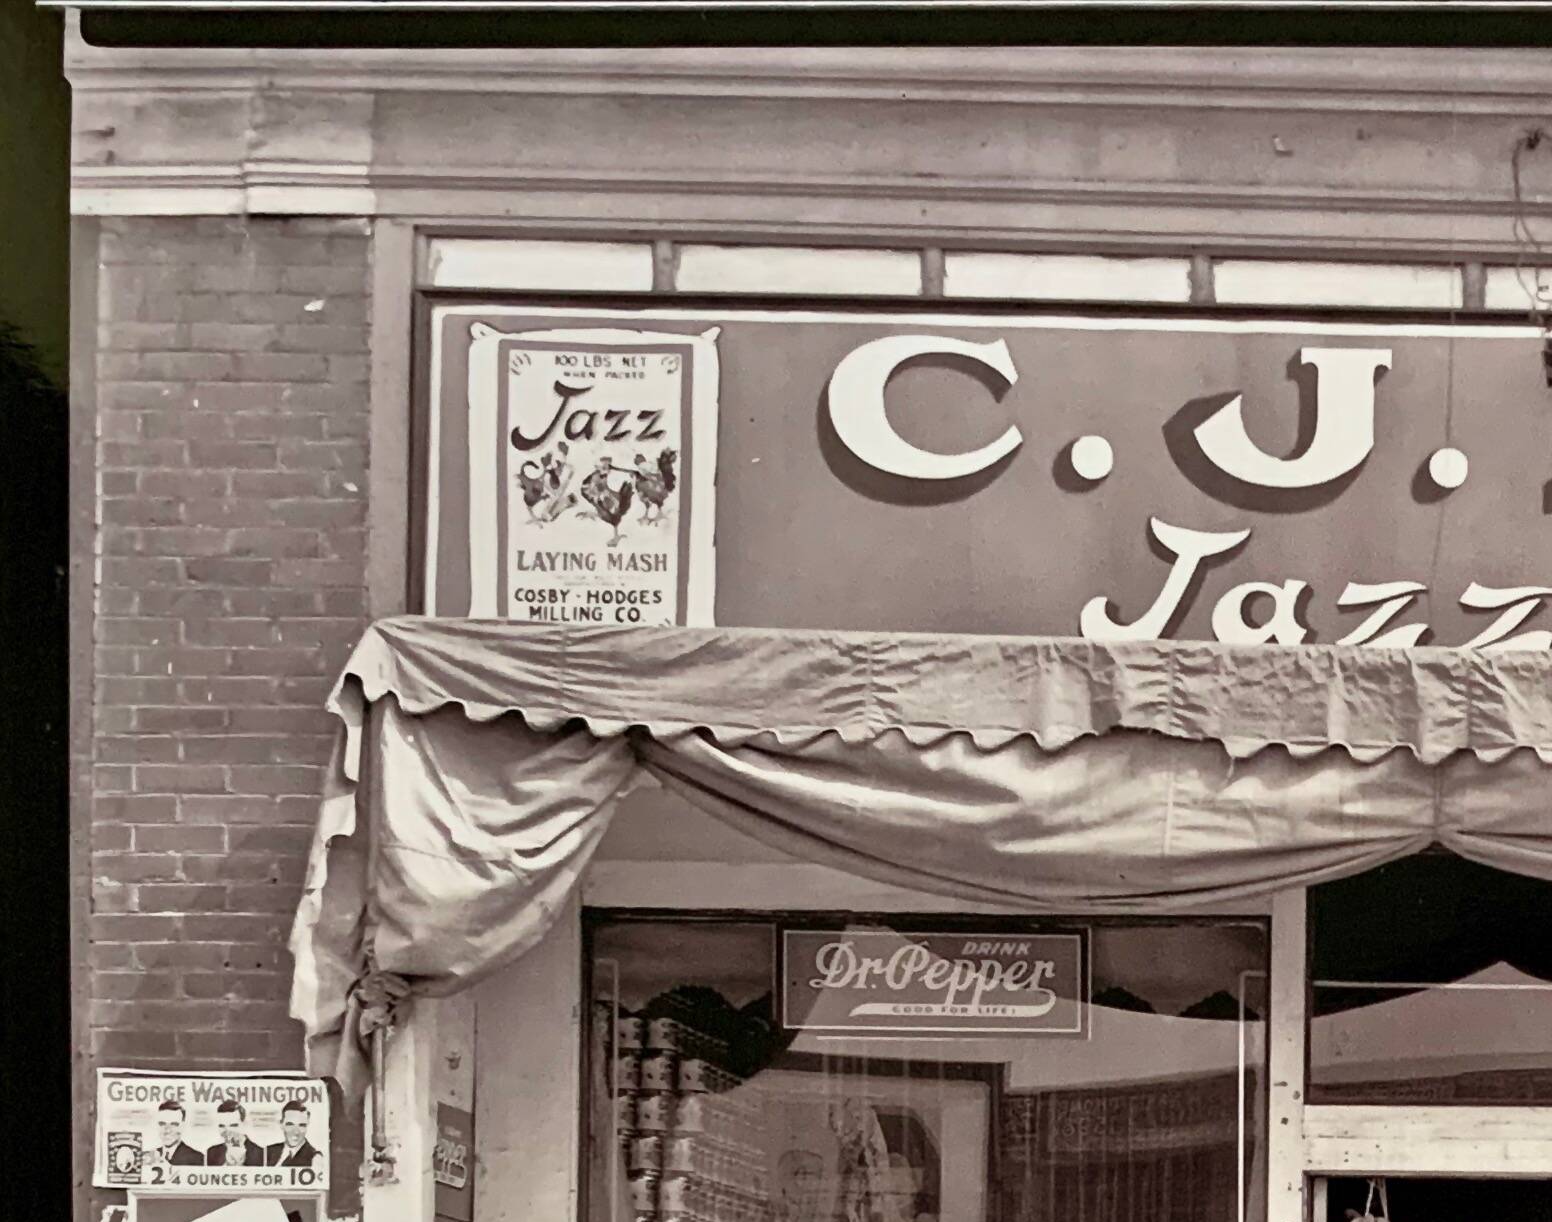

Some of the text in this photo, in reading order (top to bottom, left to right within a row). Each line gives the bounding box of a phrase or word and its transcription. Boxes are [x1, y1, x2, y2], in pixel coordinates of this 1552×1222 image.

[584, 356, 612, 367] LBS
[511, 379, 667, 451] Jazz
[516, 550, 668, 573] LAYING MASH
[514, 588, 571, 604] COSBY
[586, 588, 663, 605] HODGES
[529, 605, 603, 622] MILLING
[961, 941, 1031, 956] DRINK
[941, 1006, 968, 1014] FOR
[107, 1081, 323, 1103] GEORGE WASHINGTON
[187, 1172, 248, 1186] OUNCES
[254, 1172, 283, 1186] FOR
